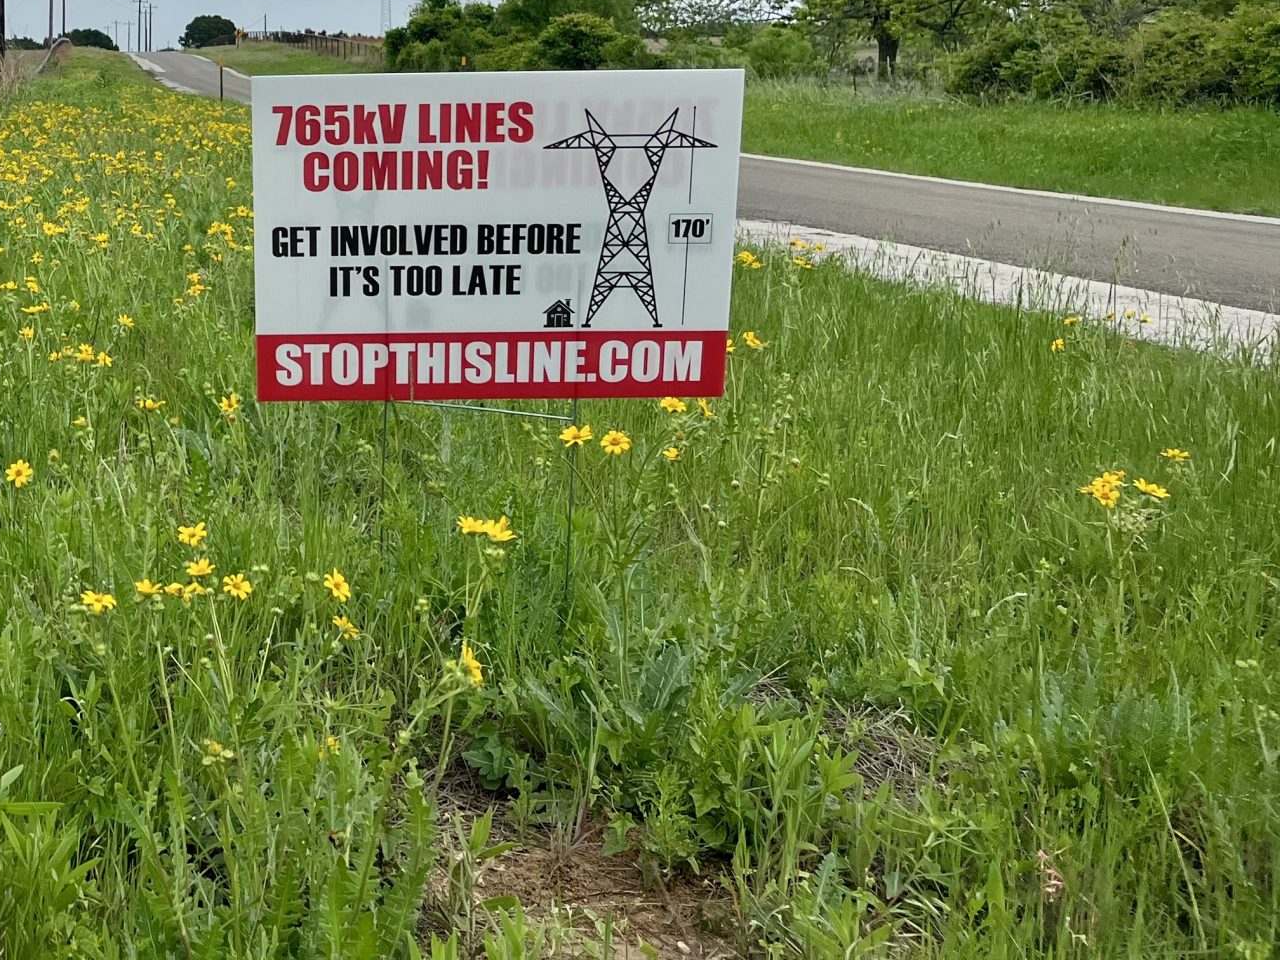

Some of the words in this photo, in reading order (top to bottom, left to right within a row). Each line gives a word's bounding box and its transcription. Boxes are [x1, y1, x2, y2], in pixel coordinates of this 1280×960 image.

[272, 103, 407, 146] 765kV
[418, 101, 534, 143] LINES
[303, 149, 490, 192] COMING!
[271, 225, 321, 258] GET
[331, 224, 467, 257] INVOLVED
[477, 223, 582, 255] BEFORE
[671, 218, 711, 239] 170'
[329, 265, 380, 297] IT'S
[390, 265, 443, 296] TOO
[452, 264, 521, 296] LATE
[275, 340, 703, 386] STOPTHISLINE.COM
